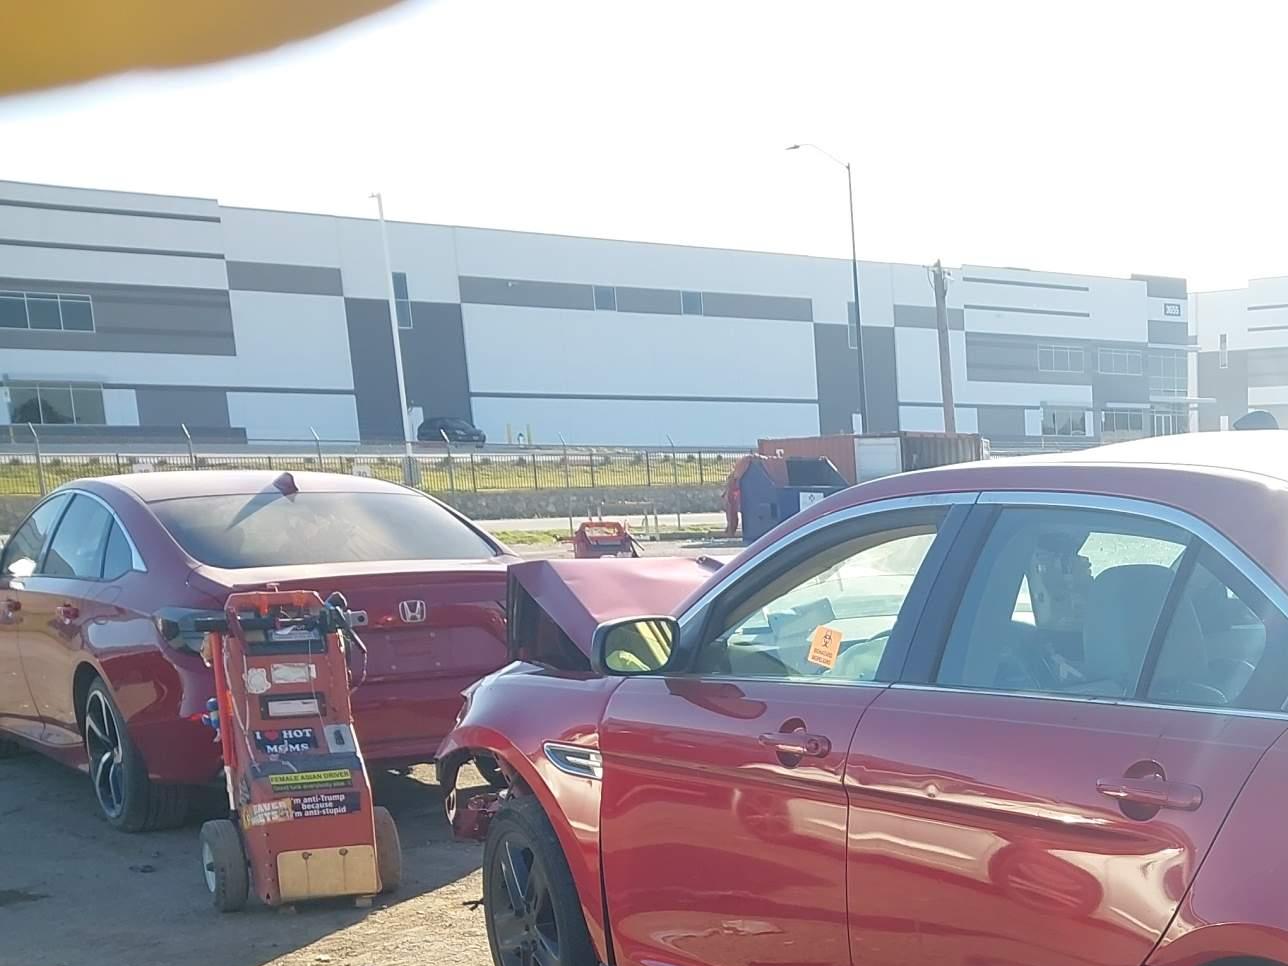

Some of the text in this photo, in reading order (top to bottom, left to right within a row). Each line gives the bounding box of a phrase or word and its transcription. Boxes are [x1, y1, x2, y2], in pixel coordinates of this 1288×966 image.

[255, 729, 312, 740] I HOT
[266, 743, 309, 753] MOMS
[271, 770, 350, 783] FEMALE ASIAN DRIVER
[302, 794, 345, 804] anti-Trump
[301, 801, 333, 810] because
[304, 805, 347, 817] anti-stupid
